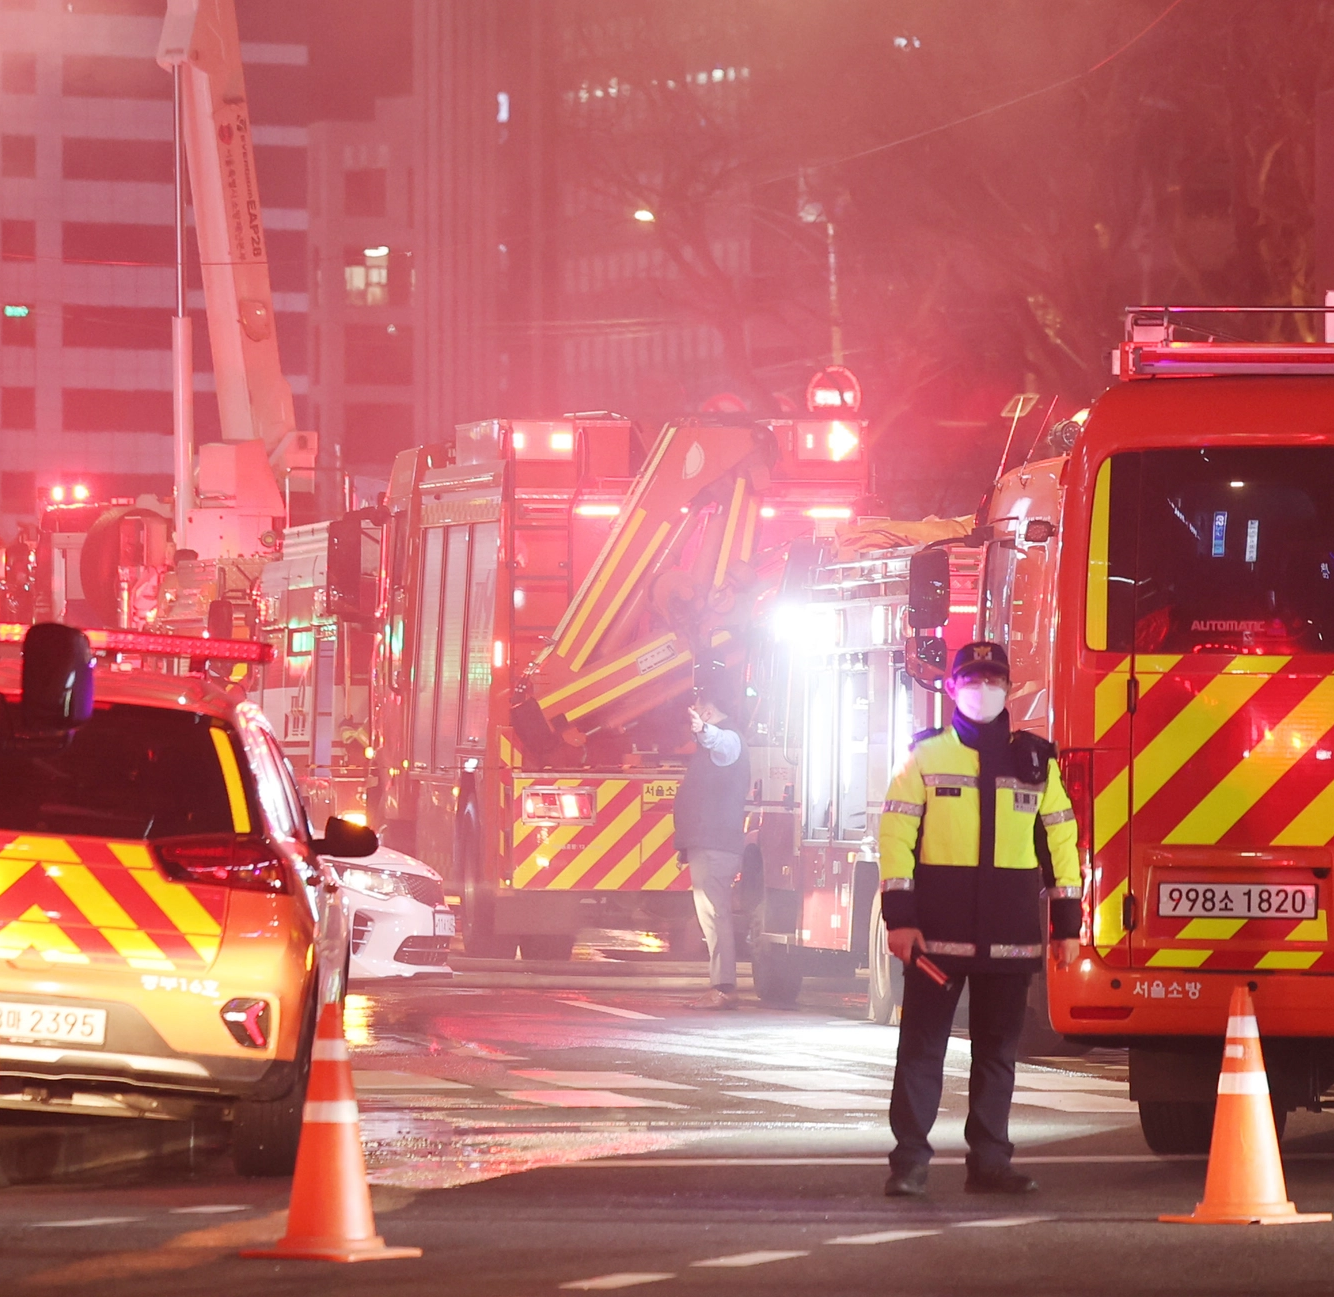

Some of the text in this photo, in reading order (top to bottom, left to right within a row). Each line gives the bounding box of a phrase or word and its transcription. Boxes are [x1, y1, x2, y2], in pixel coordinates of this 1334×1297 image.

[246, 199, 263, 258] EAP28
[1190, 619, 1266, 633] AUTOMATIC
[645, 785, 678, 798] 서울소
[1168, 887, 1307, 914] 998소 1820
[1132, 979, 1202, 1001] 서울소방
[29, 1009, 95, 1038] 2395
